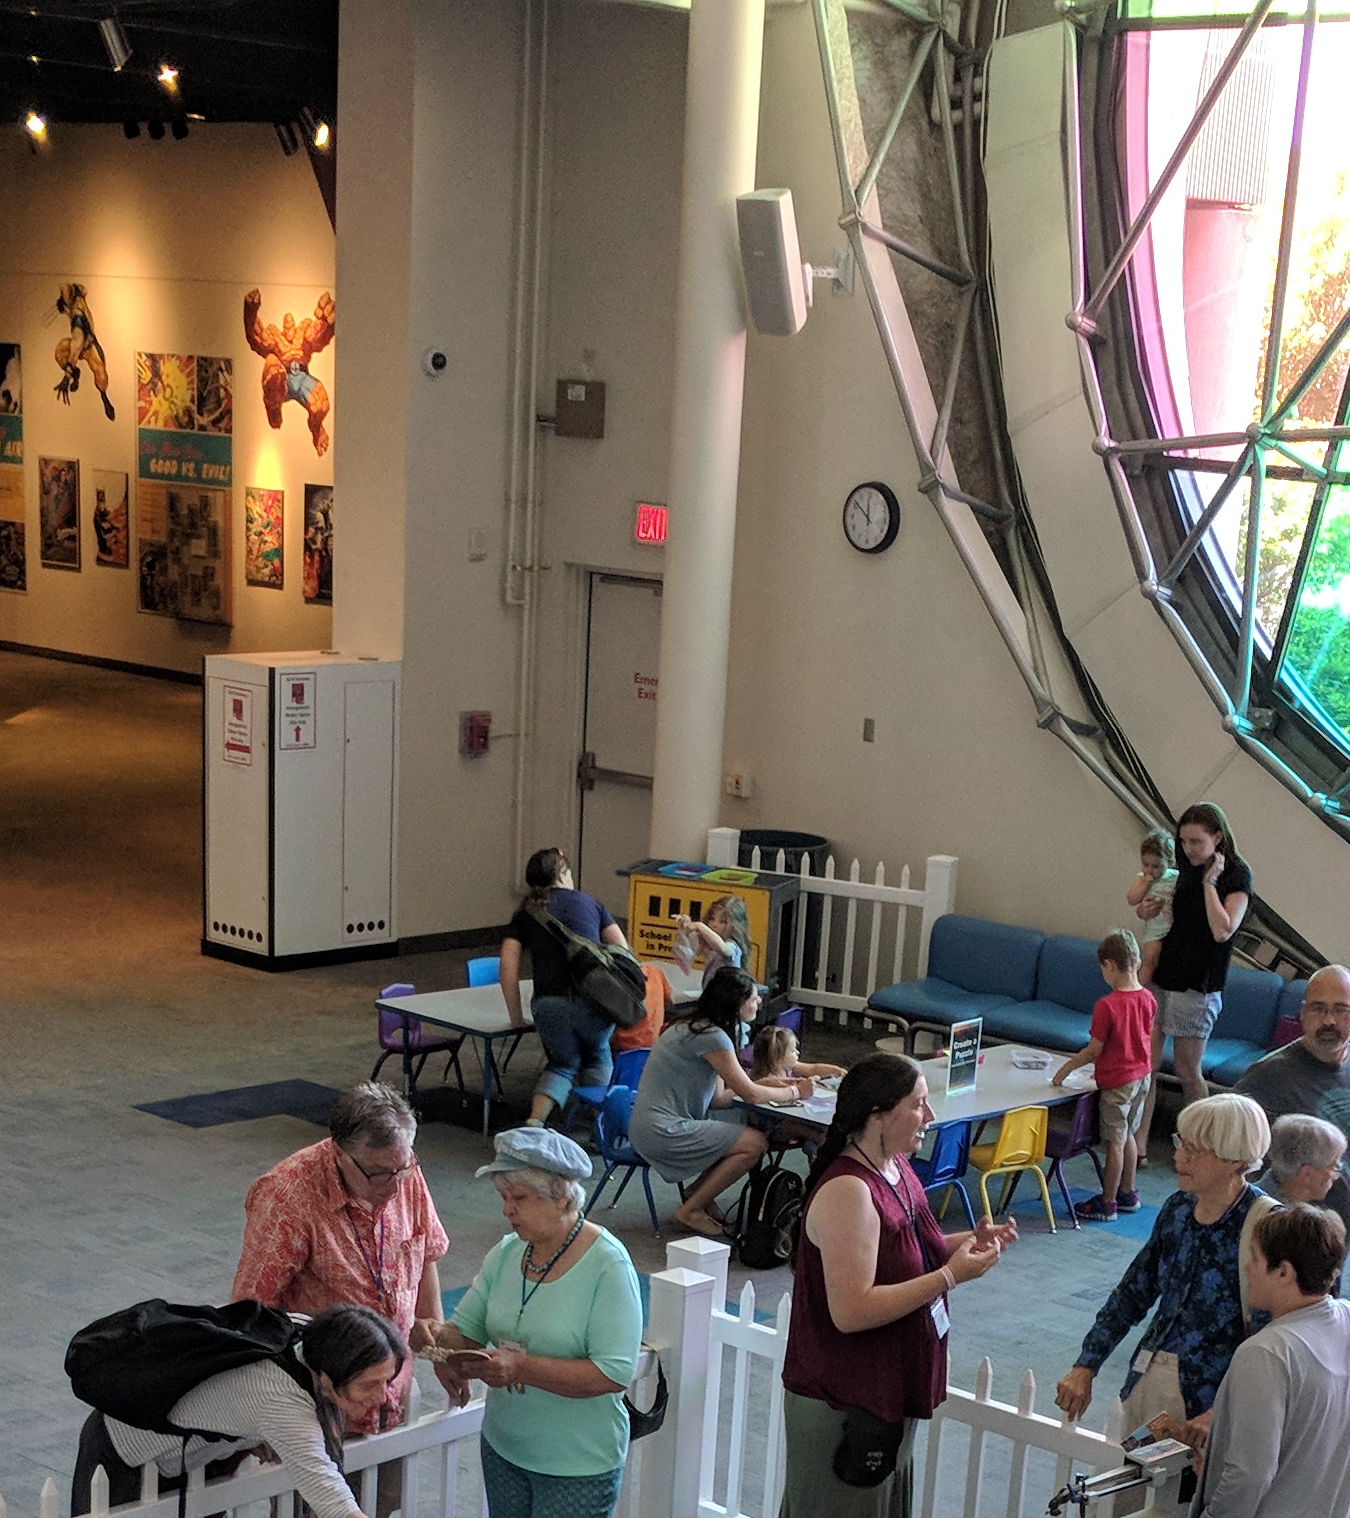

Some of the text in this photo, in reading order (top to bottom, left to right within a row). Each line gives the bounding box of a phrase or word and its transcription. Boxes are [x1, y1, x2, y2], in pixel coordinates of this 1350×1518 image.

[150, 459, 178, 475] GOOD
[638, 507, 668, 540] EXIT
[634, 672, 659, 686] Emer
[638, 929, 672, 941] School
[646, 940, 656, 951] in
